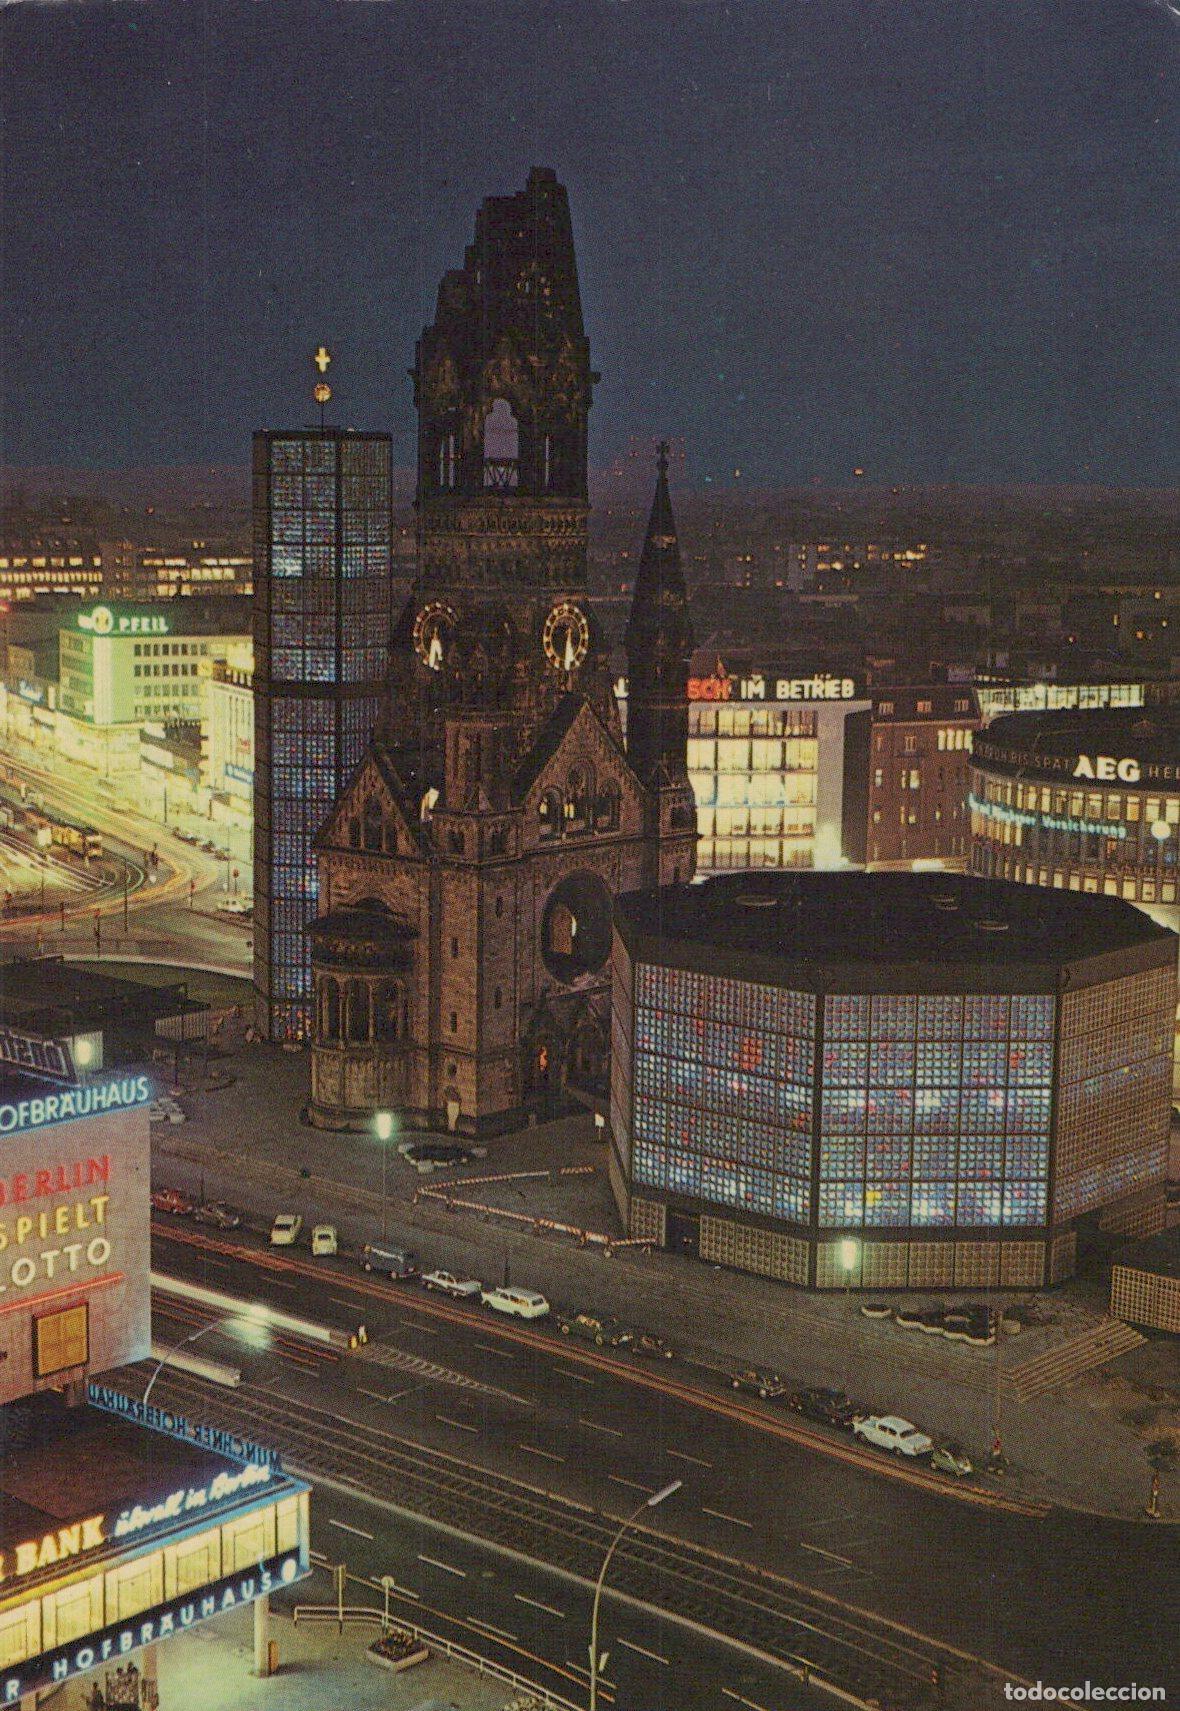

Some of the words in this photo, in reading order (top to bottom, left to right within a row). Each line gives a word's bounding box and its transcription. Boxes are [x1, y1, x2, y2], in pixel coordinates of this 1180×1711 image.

[740, 679, 765, 699] IM
[776, 679, 854, 699] BETRIEB
[1072, 755, 1141, 782] AEG
[15, 1513, 105, 1576] BANK
